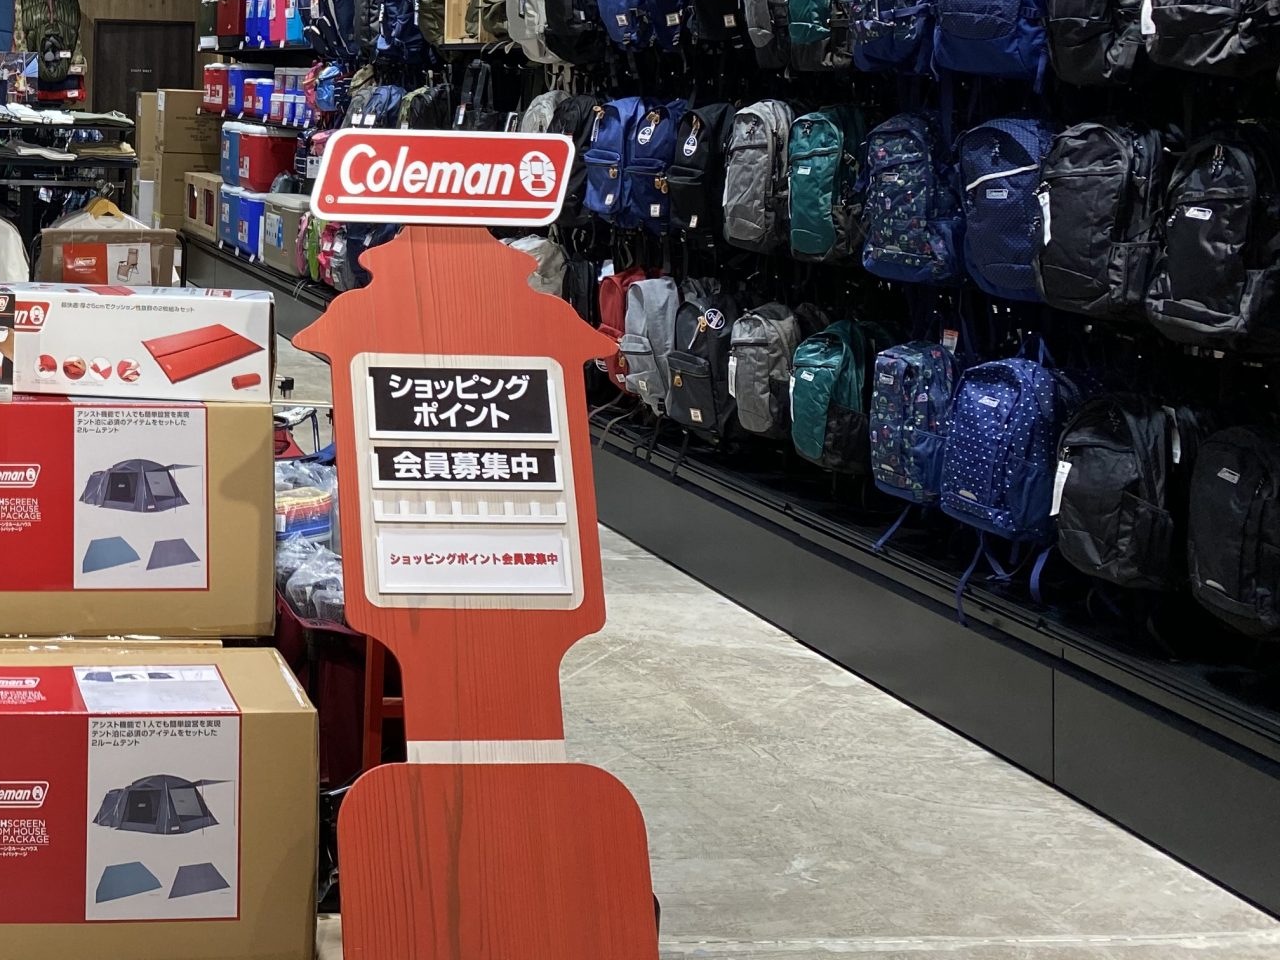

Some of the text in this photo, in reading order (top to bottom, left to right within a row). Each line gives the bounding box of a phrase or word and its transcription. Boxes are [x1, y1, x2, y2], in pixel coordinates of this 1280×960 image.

[339, 143, 516, 196] Coleman
[388, 374, 530, 400] ショッピング
[413, 402, 510, 428] ポイント
[392, 450, 539, 480] 会員募集中
[0, 512, 42, 520] PACKAGE
[9, 505, 39, 513] HOUSE
[389, 552, 559, 566] ショッピングポイント会員募集中
[13, 827, 47, 836] HOUSE
[2, 835, 50, 844] PACKAGE
